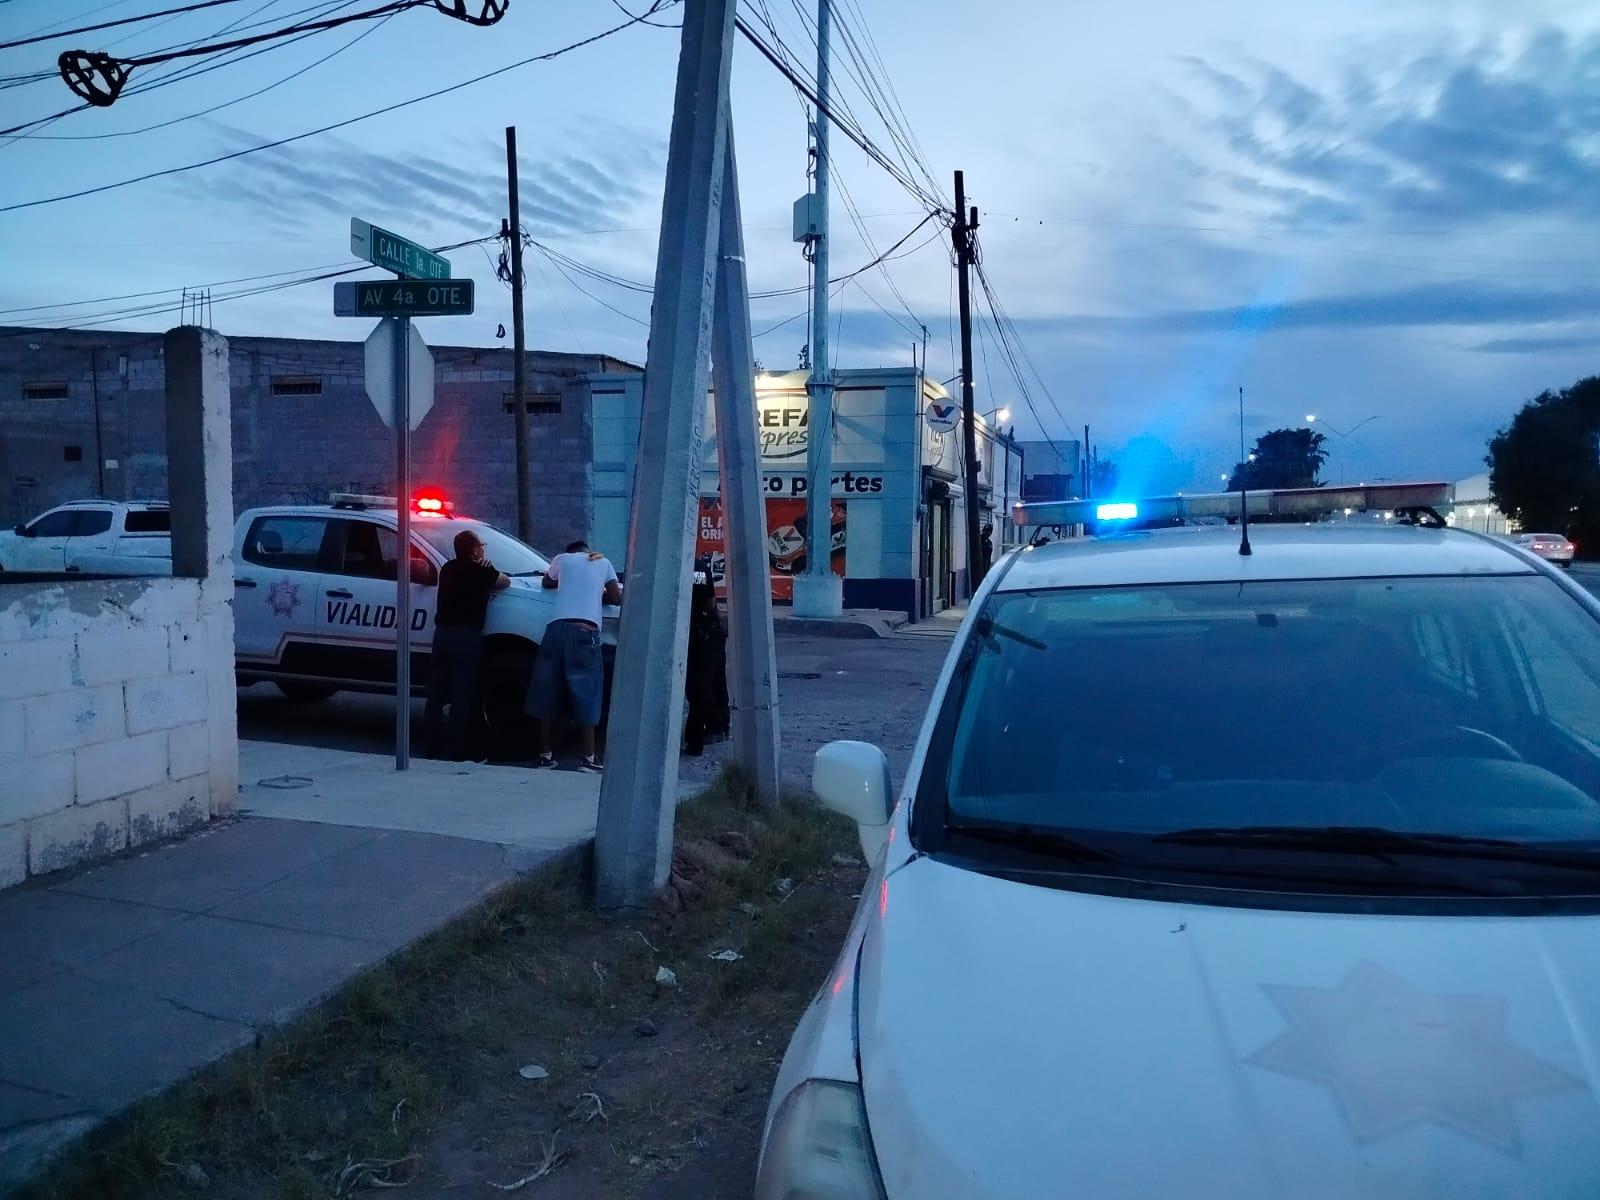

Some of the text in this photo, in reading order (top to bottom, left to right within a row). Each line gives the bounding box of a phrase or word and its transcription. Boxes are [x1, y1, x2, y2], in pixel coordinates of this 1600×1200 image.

[380, 237, 410, 265] CALLE
[701, 516, 714, 529] EL
[701, 528, 724, 541] ORI
[327, 600, 428, 631] VIALIDD
